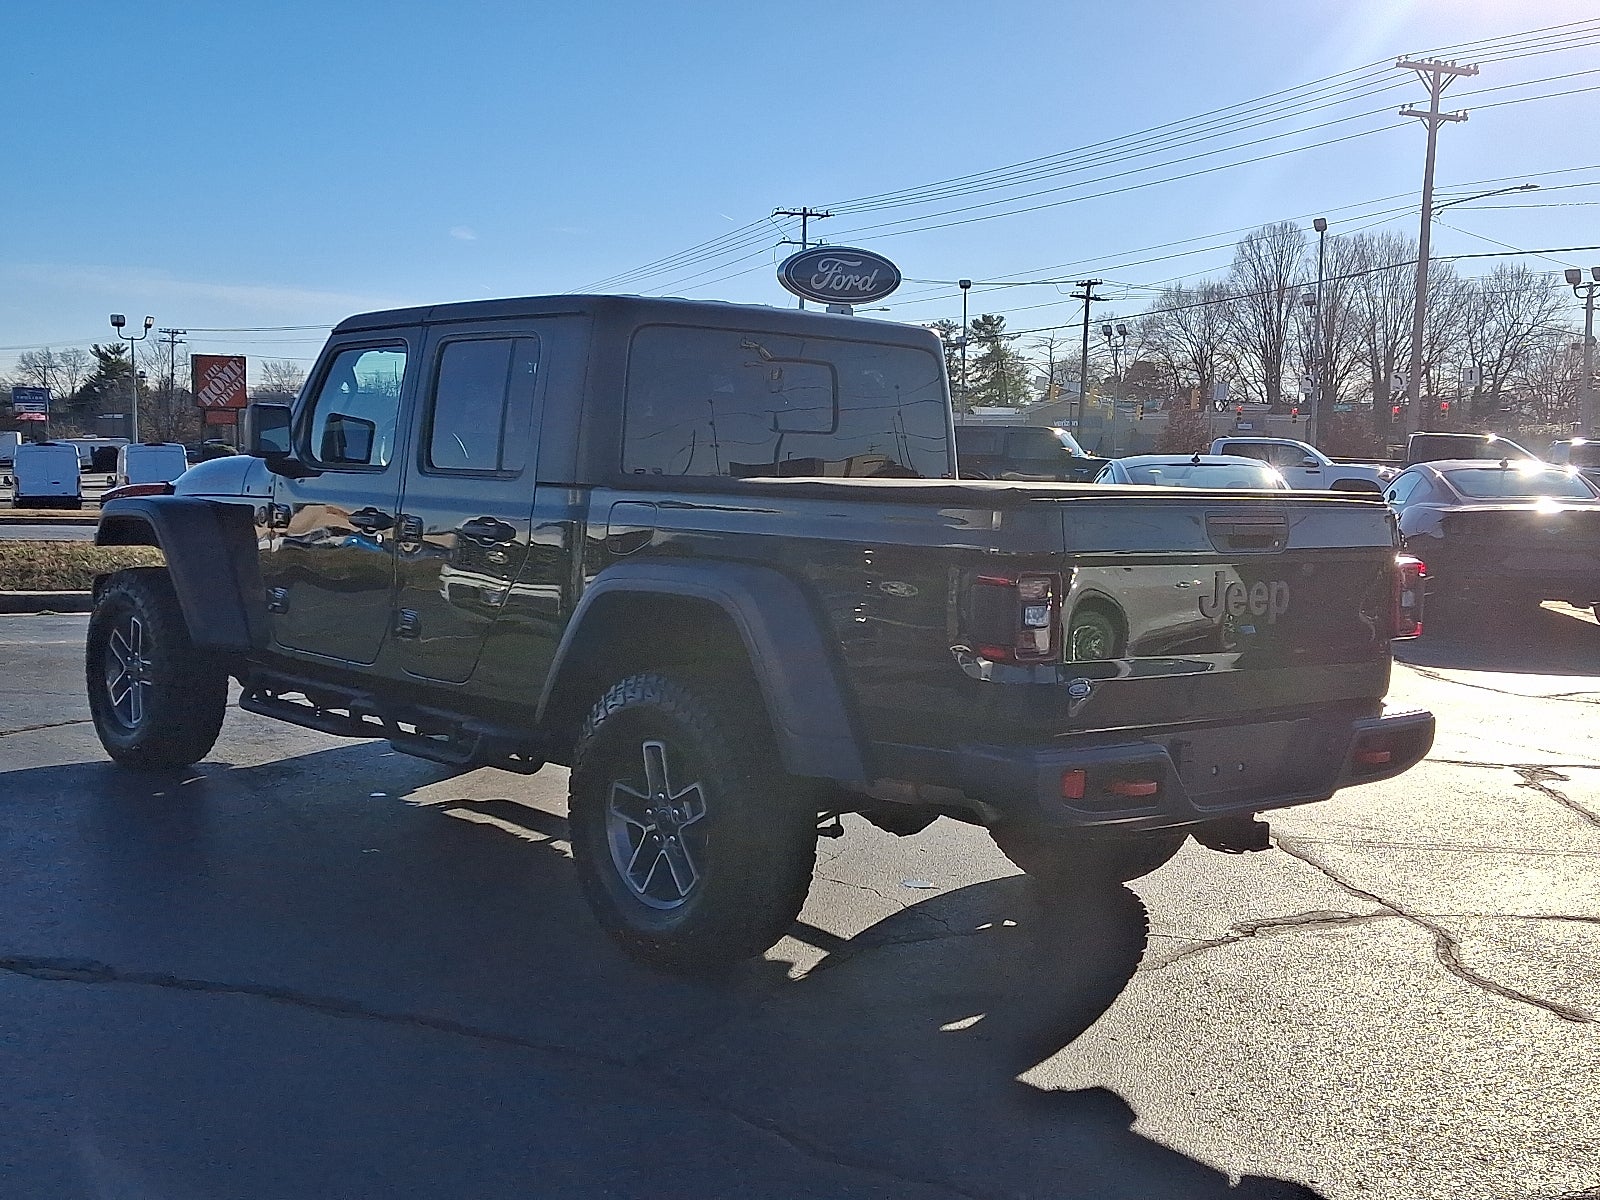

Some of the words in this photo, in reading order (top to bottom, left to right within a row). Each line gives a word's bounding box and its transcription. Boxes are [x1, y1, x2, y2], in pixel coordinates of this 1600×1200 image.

[811, 258, 879, 291] Ford
[197, 357, 244, 406] HOME
[203, 363, 223, 381] THE
[216, 376, 246, 407] DEPOT
[1198, 570, 1290, 624] Jeep
